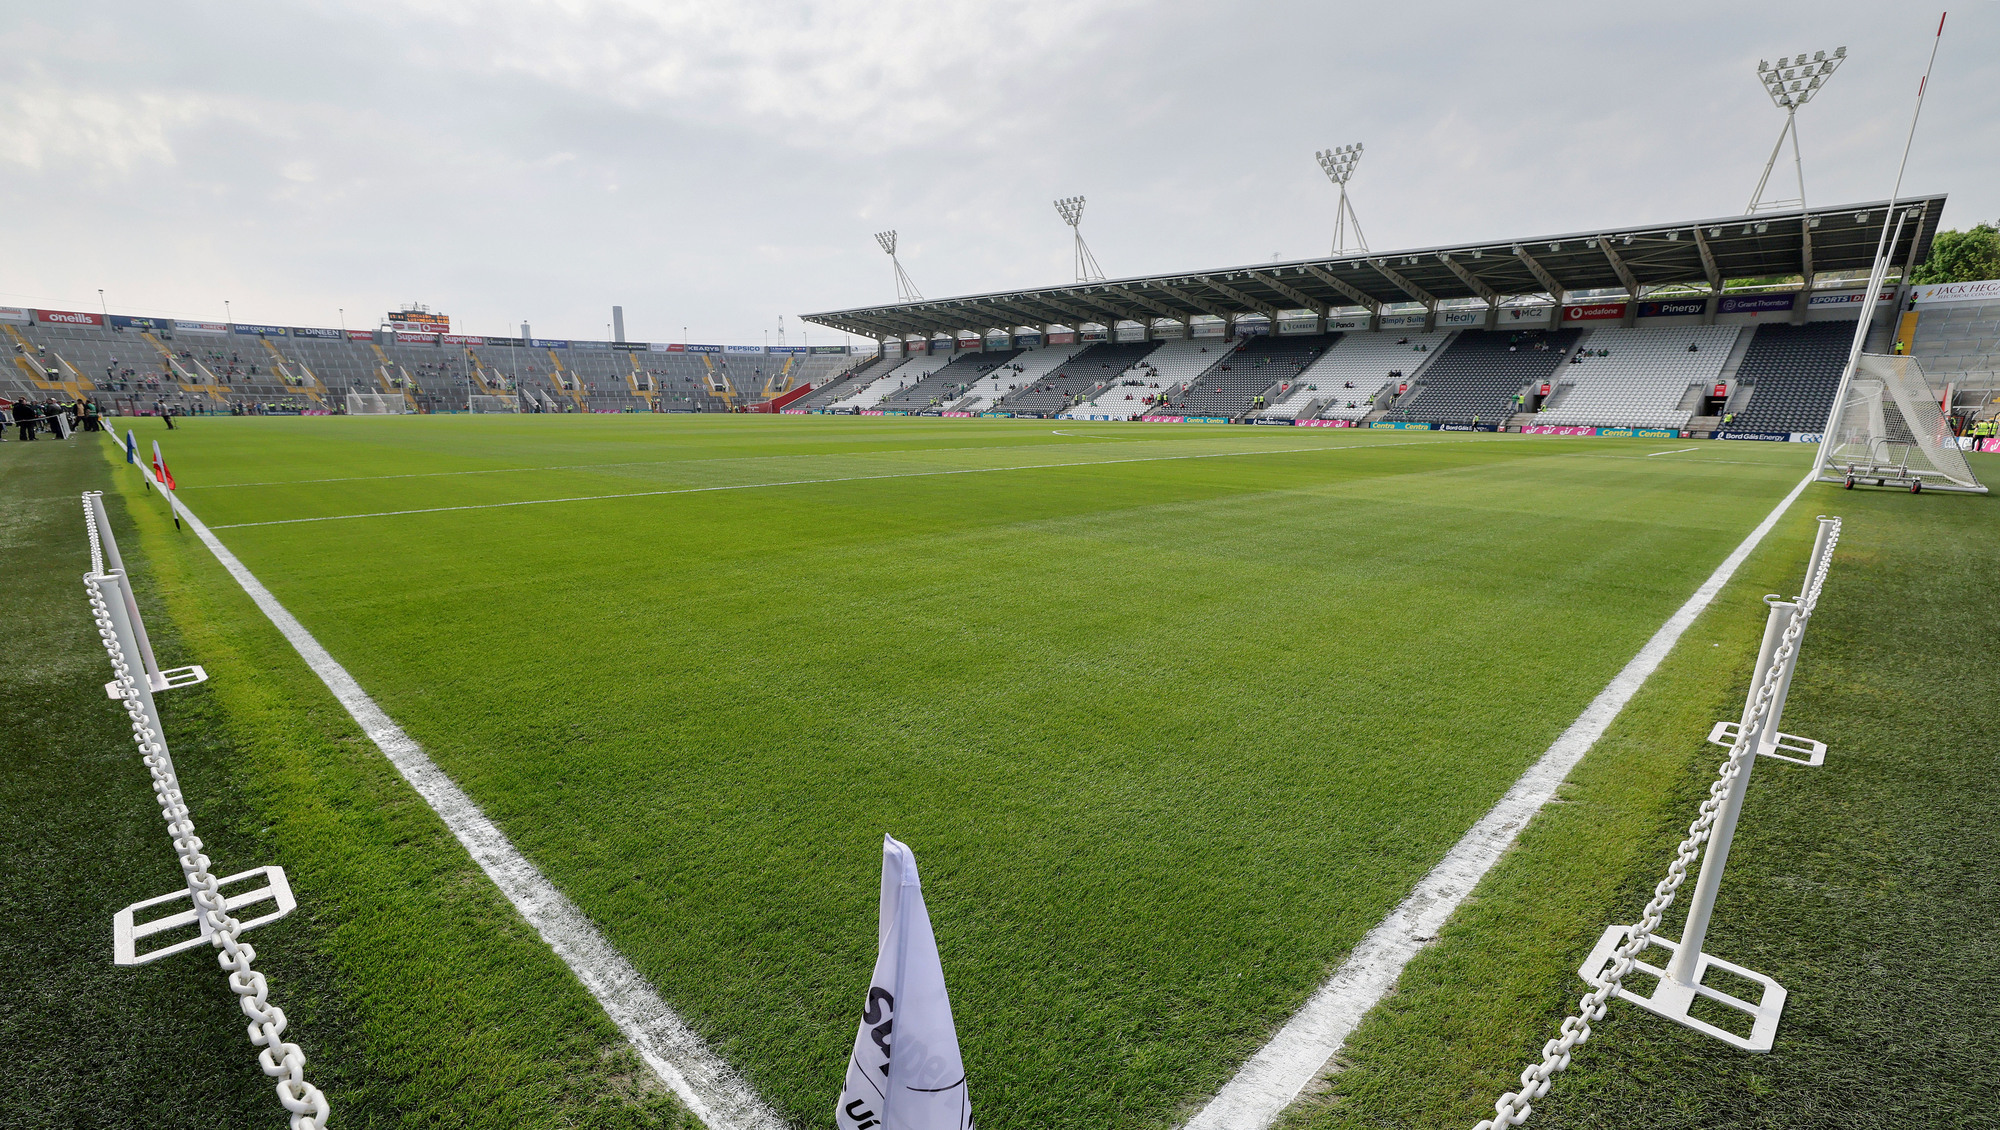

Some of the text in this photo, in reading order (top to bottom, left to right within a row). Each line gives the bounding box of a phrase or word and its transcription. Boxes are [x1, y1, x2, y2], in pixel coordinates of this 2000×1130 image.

[1936, 285, 1967, 297] JACK
[1812, 293, 1891, 303] SPORTS DICT
[1522, 309, 1542, 317] MC2
[1584, 308, 1618, 316] vodafone
[1662, 304, 1702, 313] Pinergy
[1381, 316, 1405, 325] Simply
[1446, 313, 1477, 324] Healy
[1372, 422, 1429, 431] Centra Centra
[1525, 426, 1539, 435] eir
[1542, 426, 1556, 435] eir
[1559, 427, 1573, 436] eir
[1602, 429, 1671, 439] Centra Centra
[1759, 434, 1785, 442] Energy
